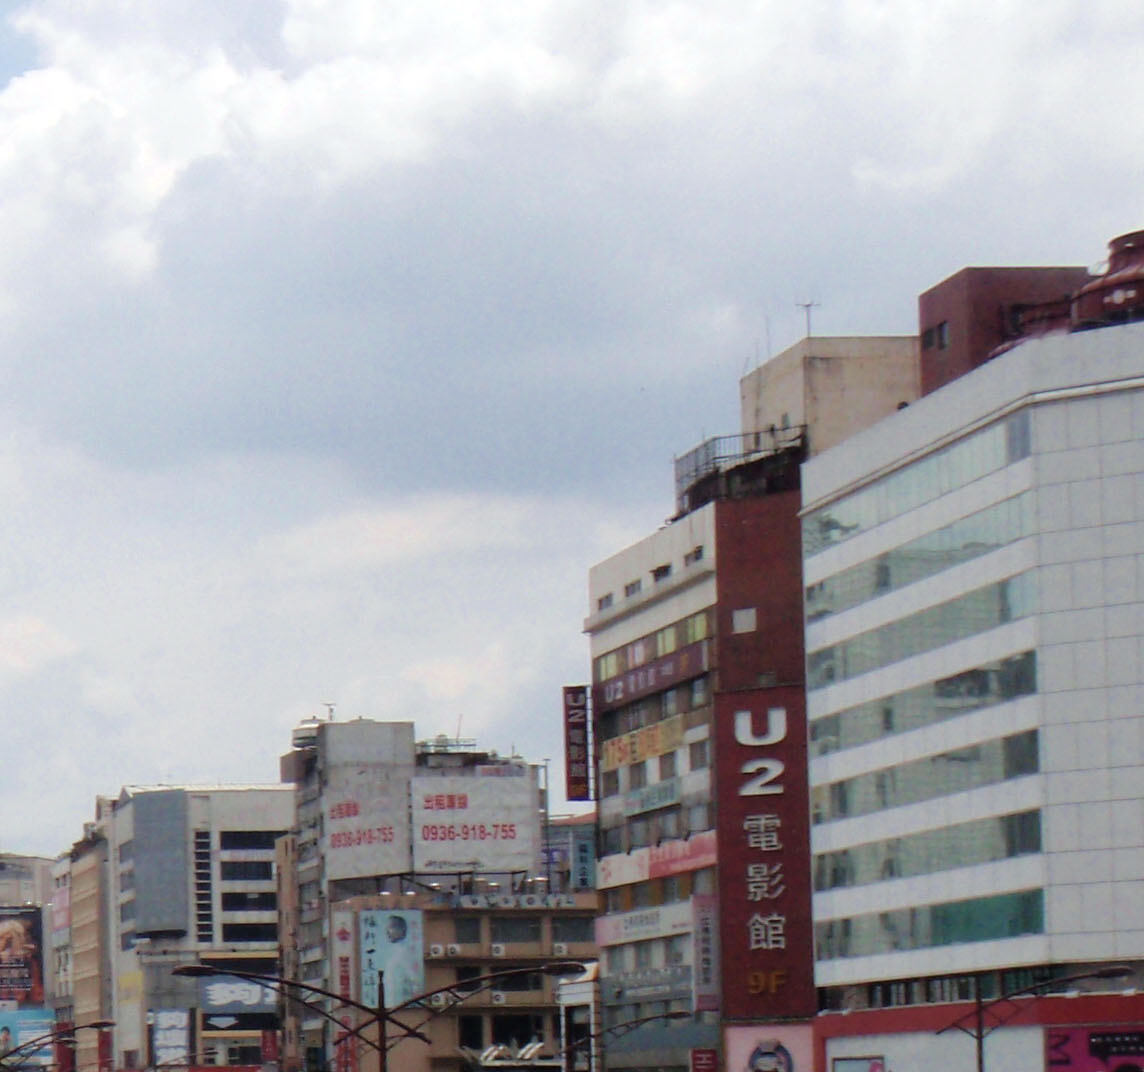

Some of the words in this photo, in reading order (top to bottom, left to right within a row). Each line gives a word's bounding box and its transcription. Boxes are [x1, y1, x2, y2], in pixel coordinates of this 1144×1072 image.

[331, 826, 395, 849] 0936-918-755
[422, 823, 516, 841] 0936-918-755
[743, 814, 787, 950] 電影館
[748, 970, 787, 995] 9F
